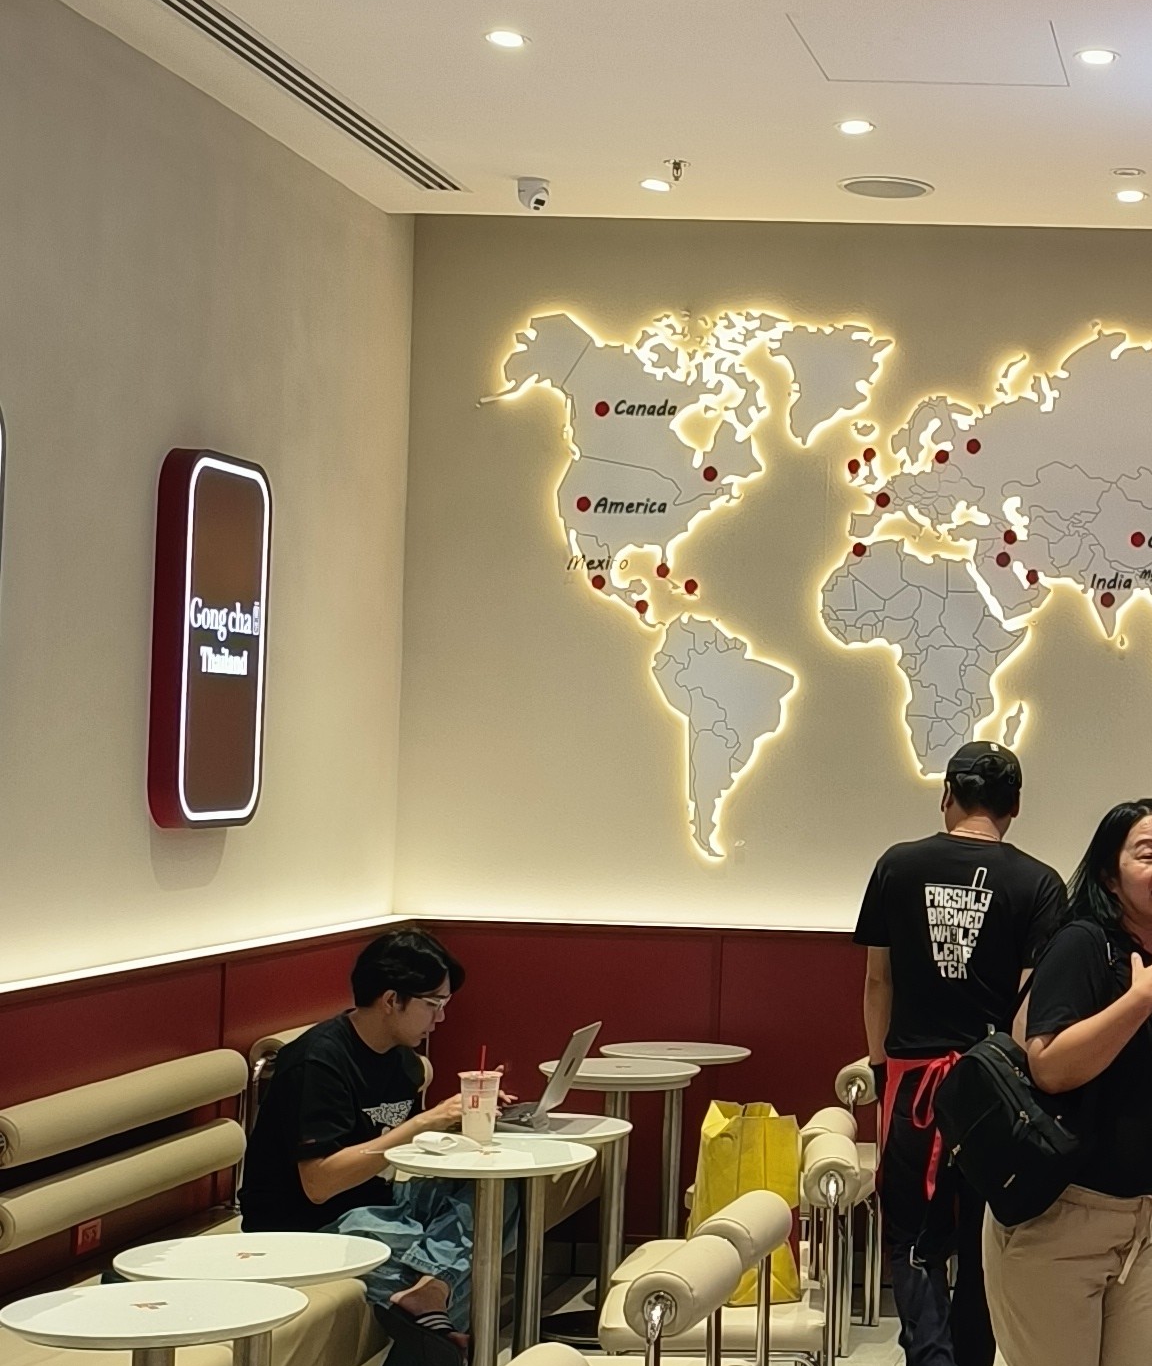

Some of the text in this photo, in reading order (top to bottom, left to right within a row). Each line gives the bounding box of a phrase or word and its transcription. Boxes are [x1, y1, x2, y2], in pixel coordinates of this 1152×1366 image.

[613, 399, 678, 417] Canada
[593, 497, 668, 514] America
[567, 555, 629, 571] Mexio
[1090, 572, 1133, 590] India
[190, 597, 252, 642] Gong cha
[200, 645, 248, 676] Thailand
[924, 886, 993, 913] FRESHLY
[927, 907, 985, 929] BREWED
[932, 942, 974, 964] LEAF
[937, 961, 968, 980] TEA
